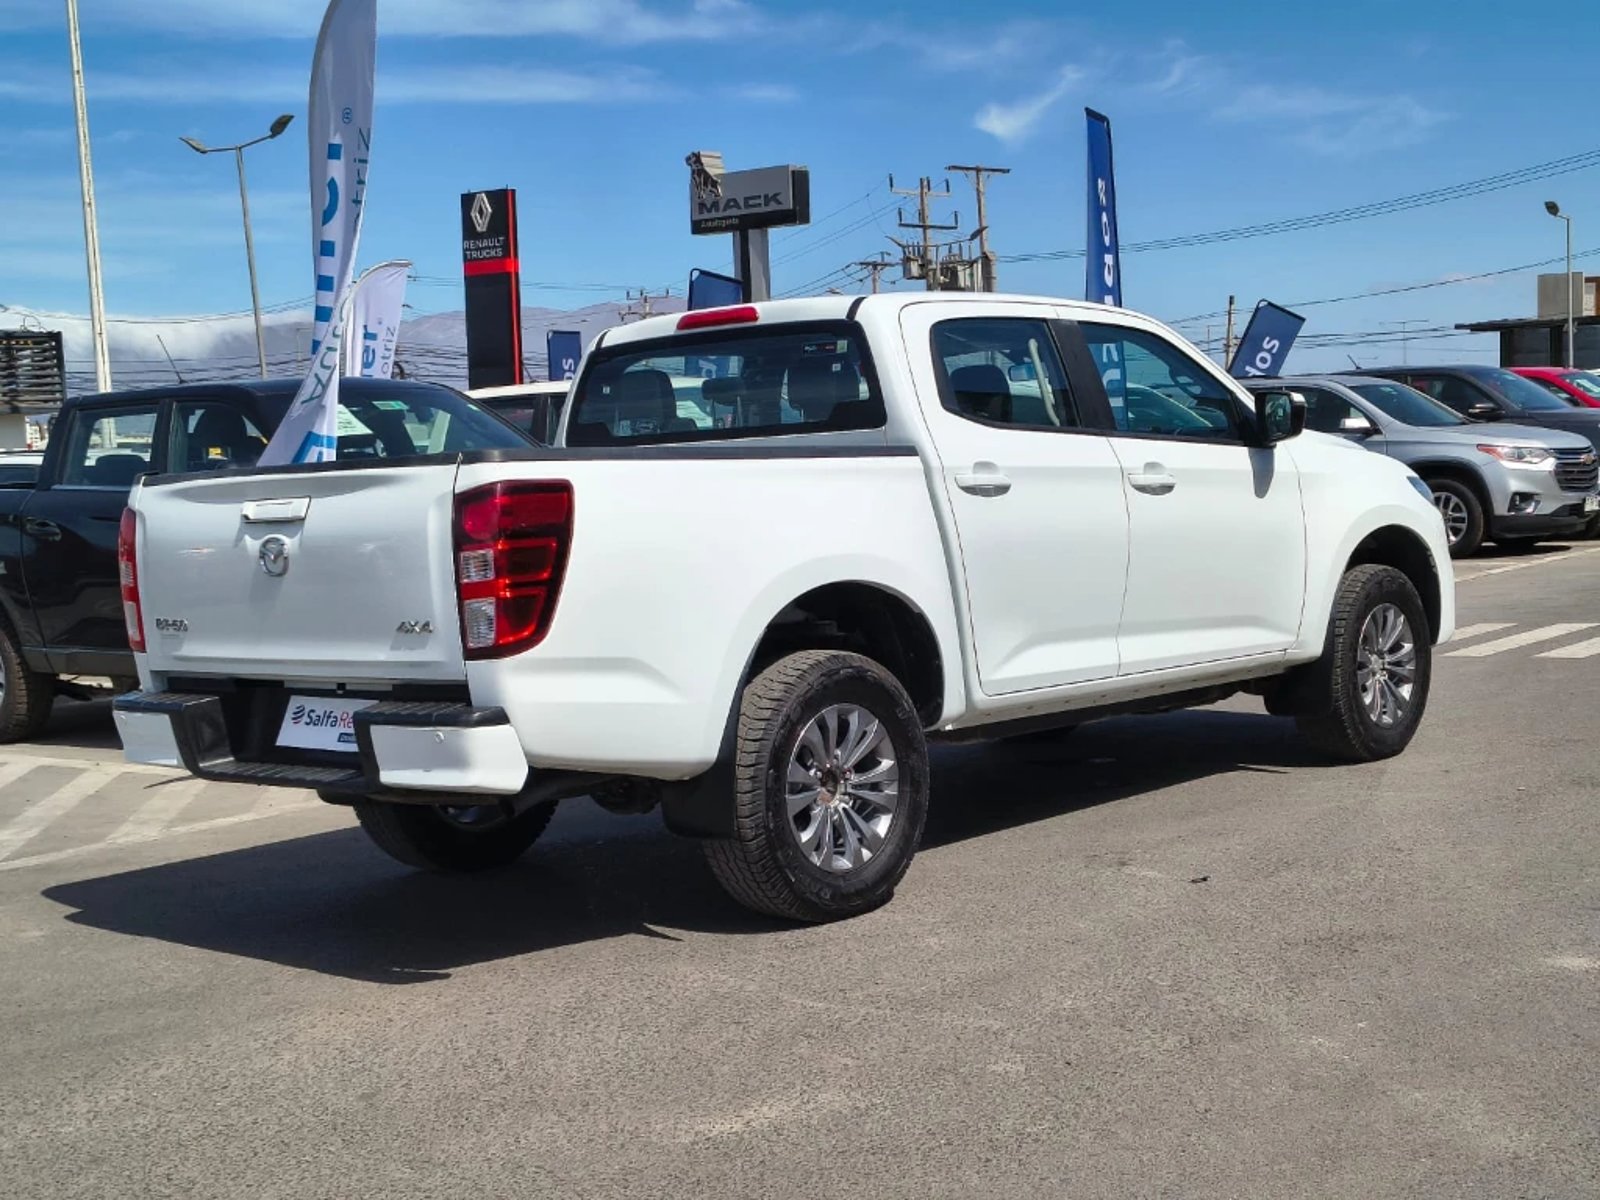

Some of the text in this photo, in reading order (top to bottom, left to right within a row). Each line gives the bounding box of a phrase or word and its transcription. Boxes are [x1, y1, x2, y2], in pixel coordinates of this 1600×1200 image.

[698, 192, 784, 215] MACK
[463, 237, 505, 250] RENAULT
[465, 248, 503, 260] TRUCKS
